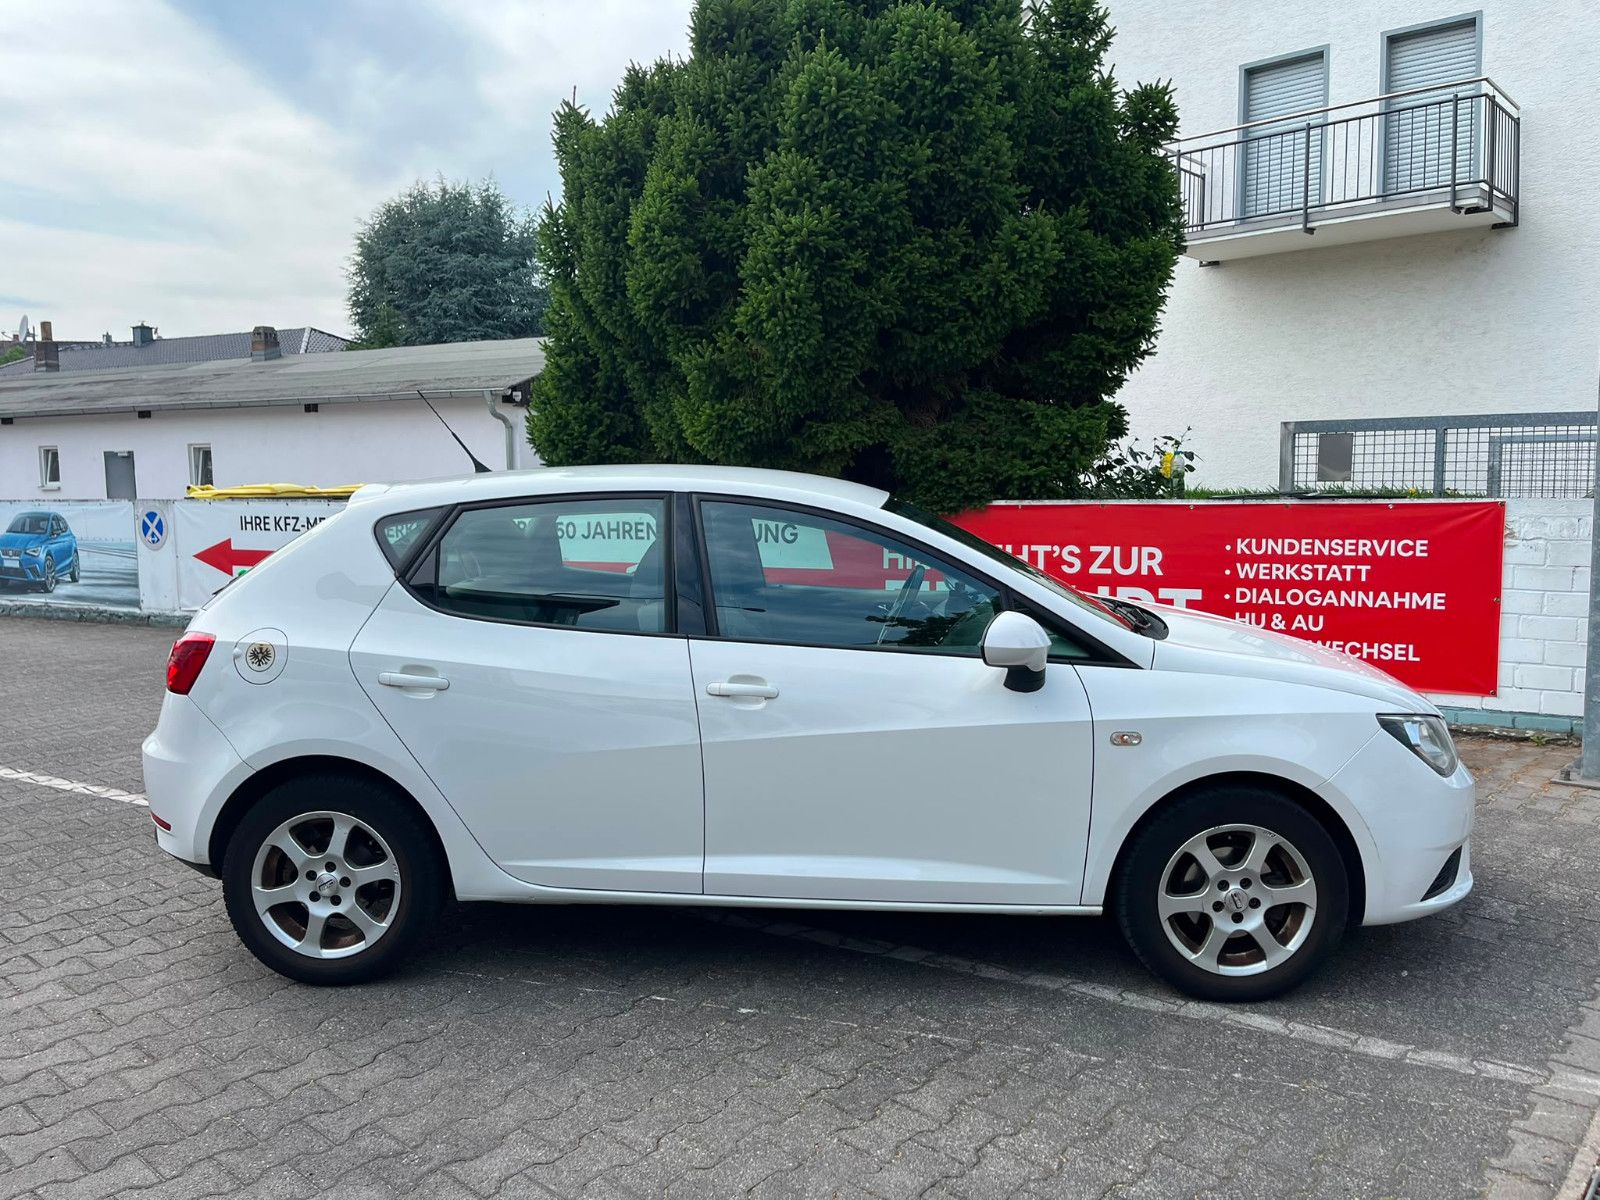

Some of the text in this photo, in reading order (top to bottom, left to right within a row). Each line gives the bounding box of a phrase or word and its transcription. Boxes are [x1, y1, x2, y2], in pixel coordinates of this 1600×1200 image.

[240, 515, 270, 531] IHRE
[581, 521, 656, 540] JAHREN
[1236, 538, 1429, 557] KUNDENSERVICE
[1088, 546, 1164, 576] ZUR
[1235, 563, 1371, 582] WERKSTATT
[1235, 587, 1446, 610] DIALOGANNAHME
[1235, 612, 1325, 632] HU & AU
